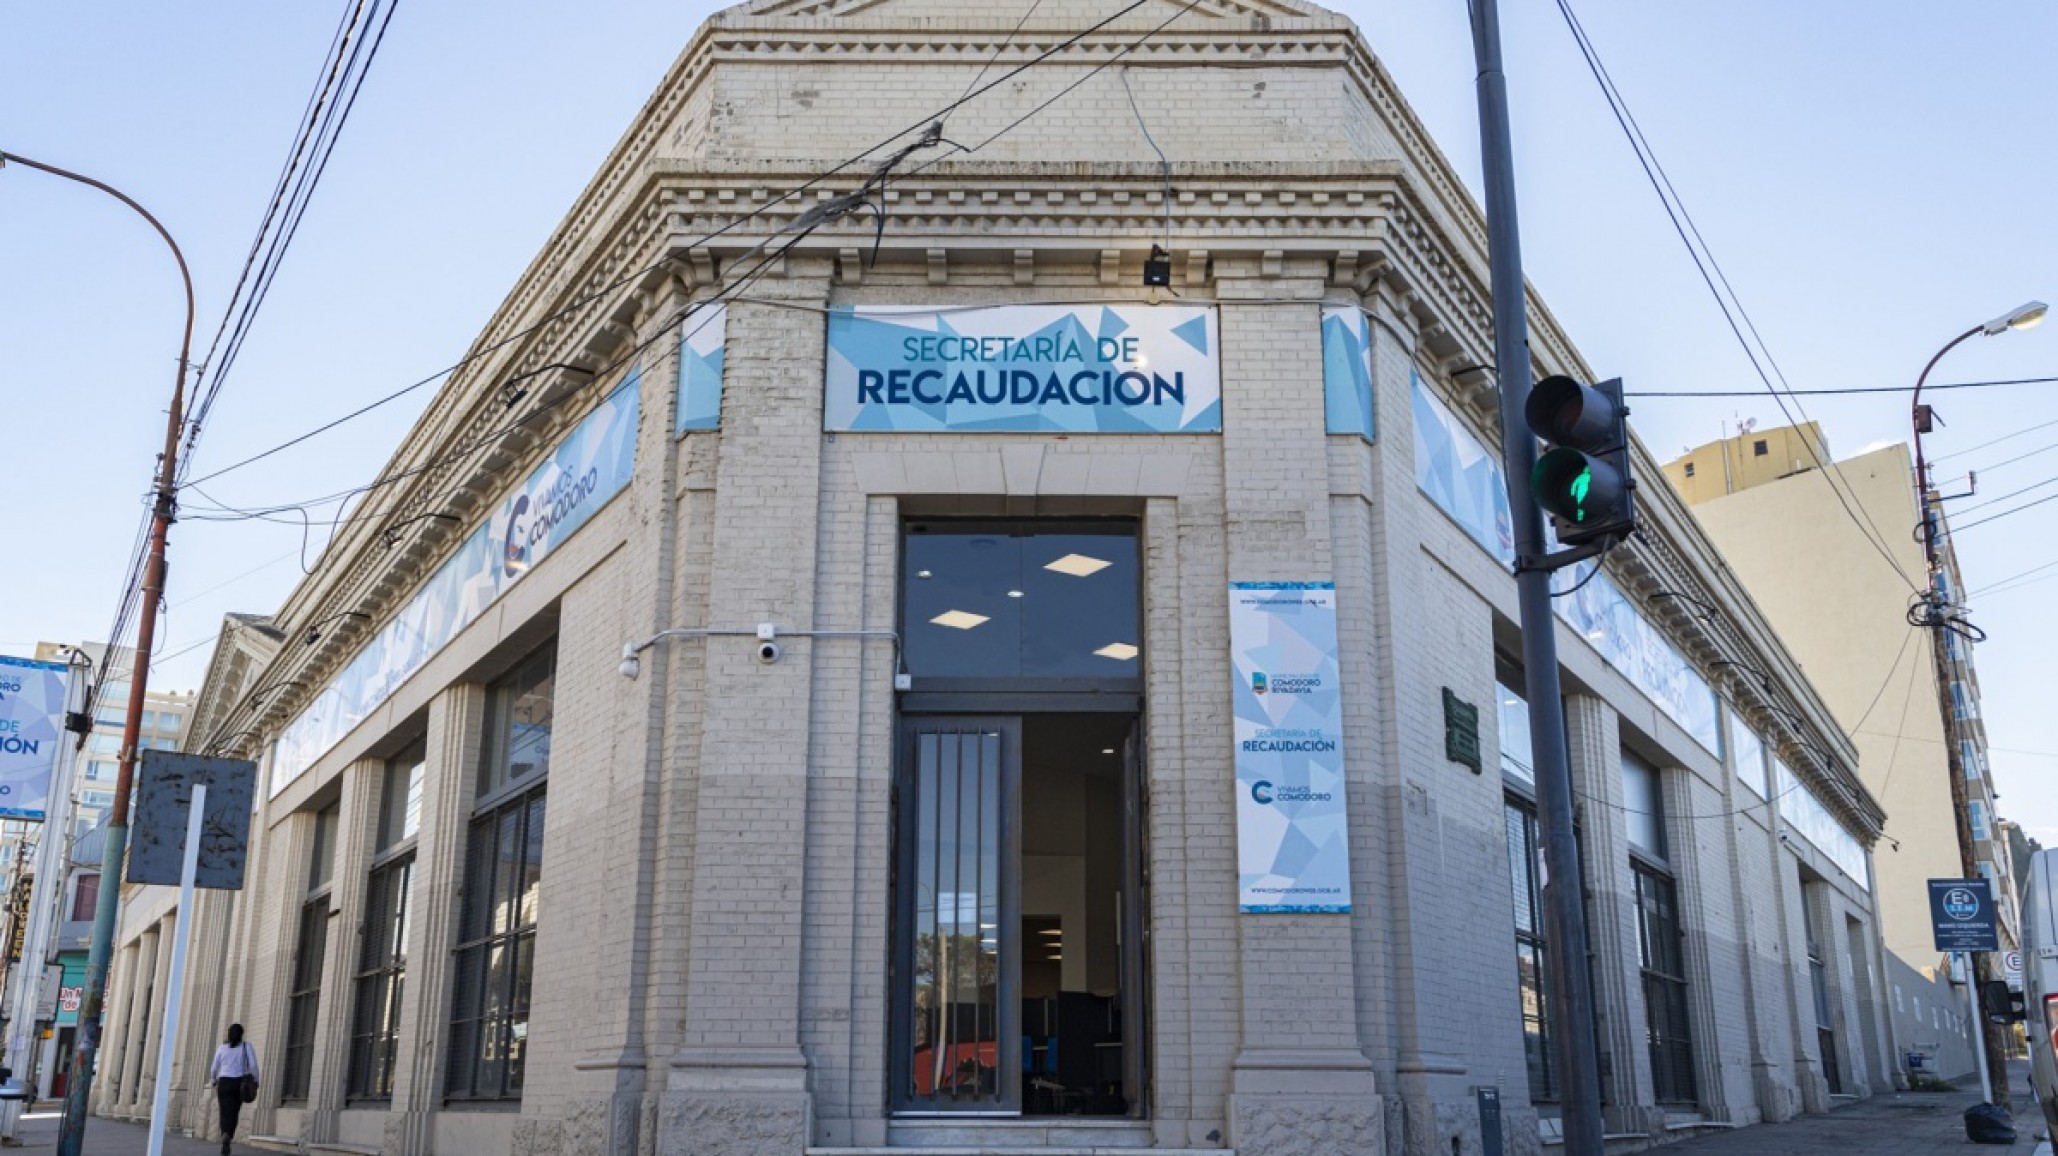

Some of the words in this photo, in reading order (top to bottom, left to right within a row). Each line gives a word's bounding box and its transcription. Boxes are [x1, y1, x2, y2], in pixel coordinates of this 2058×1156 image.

[902, 330, 1083, 362] SECRETARÍA
[1098, 336, 1139, 362] DE
[530, 465, 598, 546] COMODORO
[1271, 678, 1321, 687] COMODORO
[1309, 729, 1323, 738] DE
[1242, 738, 1335, 752] RECAUDACIÓN
[1277, 793, 1332, 802] COMODORO
